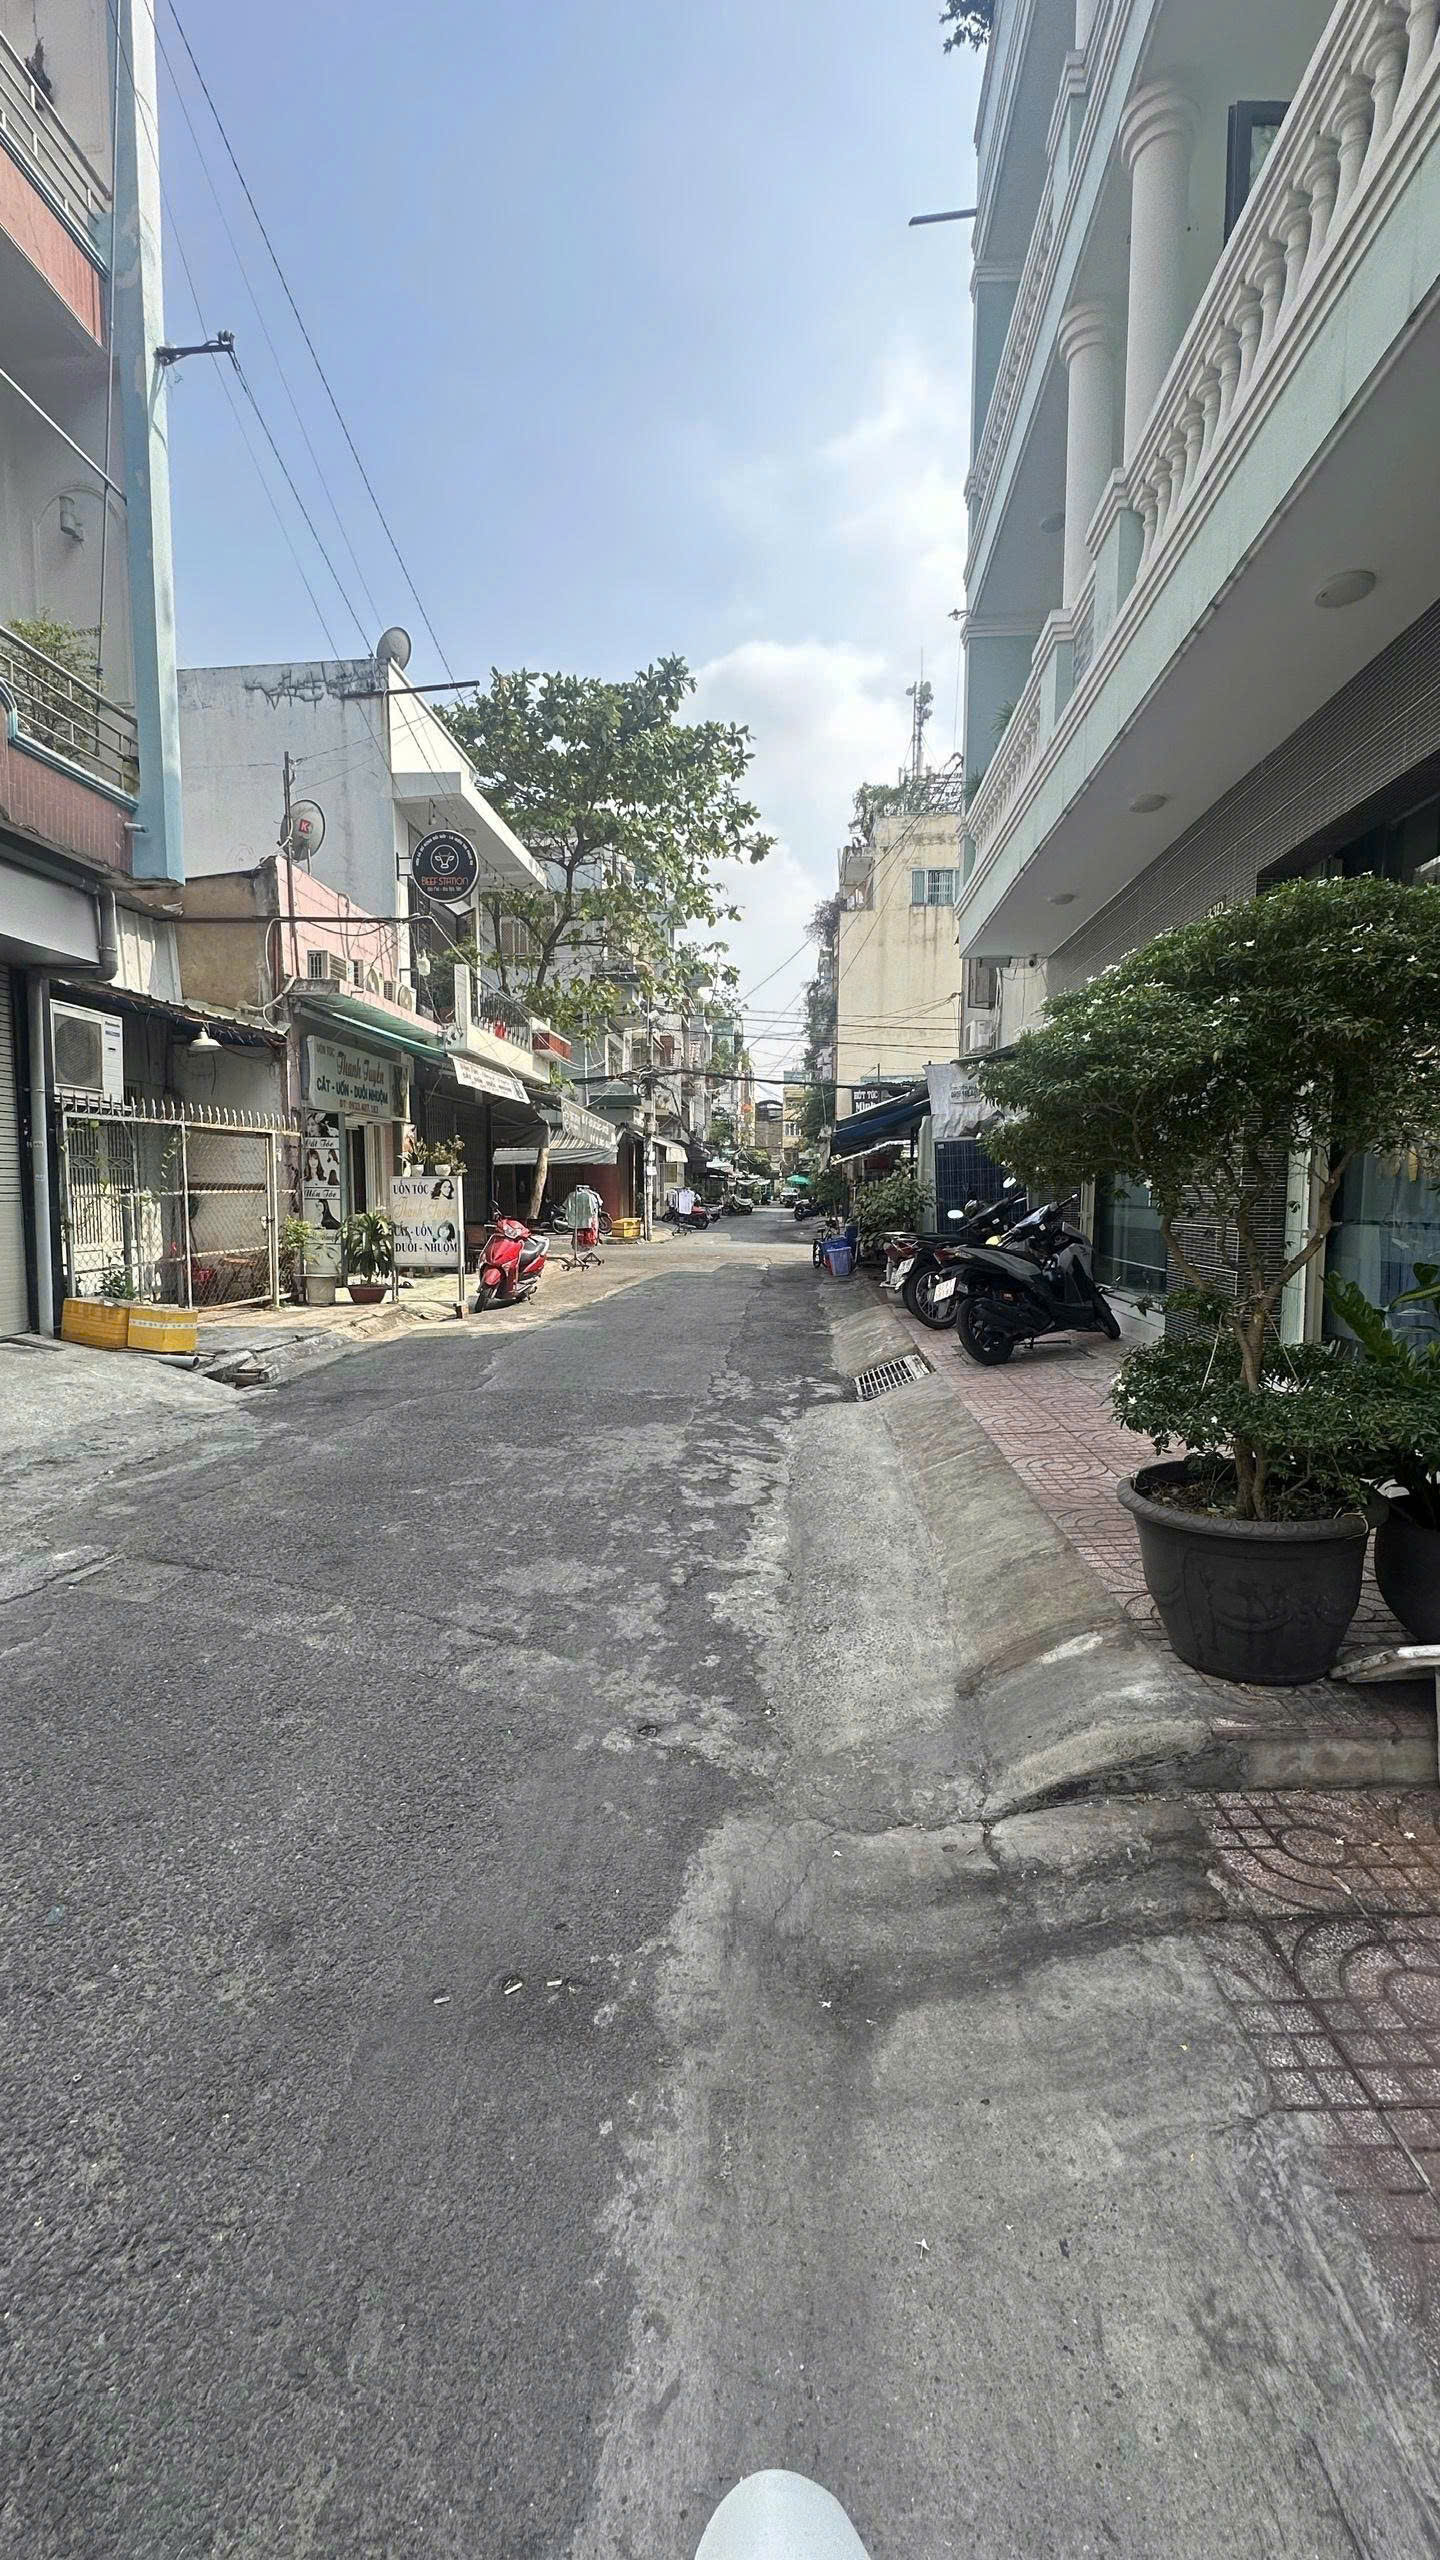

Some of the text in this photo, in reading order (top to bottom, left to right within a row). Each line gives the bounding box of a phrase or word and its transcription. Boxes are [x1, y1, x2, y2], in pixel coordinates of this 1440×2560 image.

[316, 1075, 331, 1093] CẮT
[336, 1079, 350, 1096] UỐN
[393, 1180, 429, 1195] UỐN TÓC
[415, 1221, 433, 1237] UỐN
[424, 1241, 458, 1256] NHUỘM
